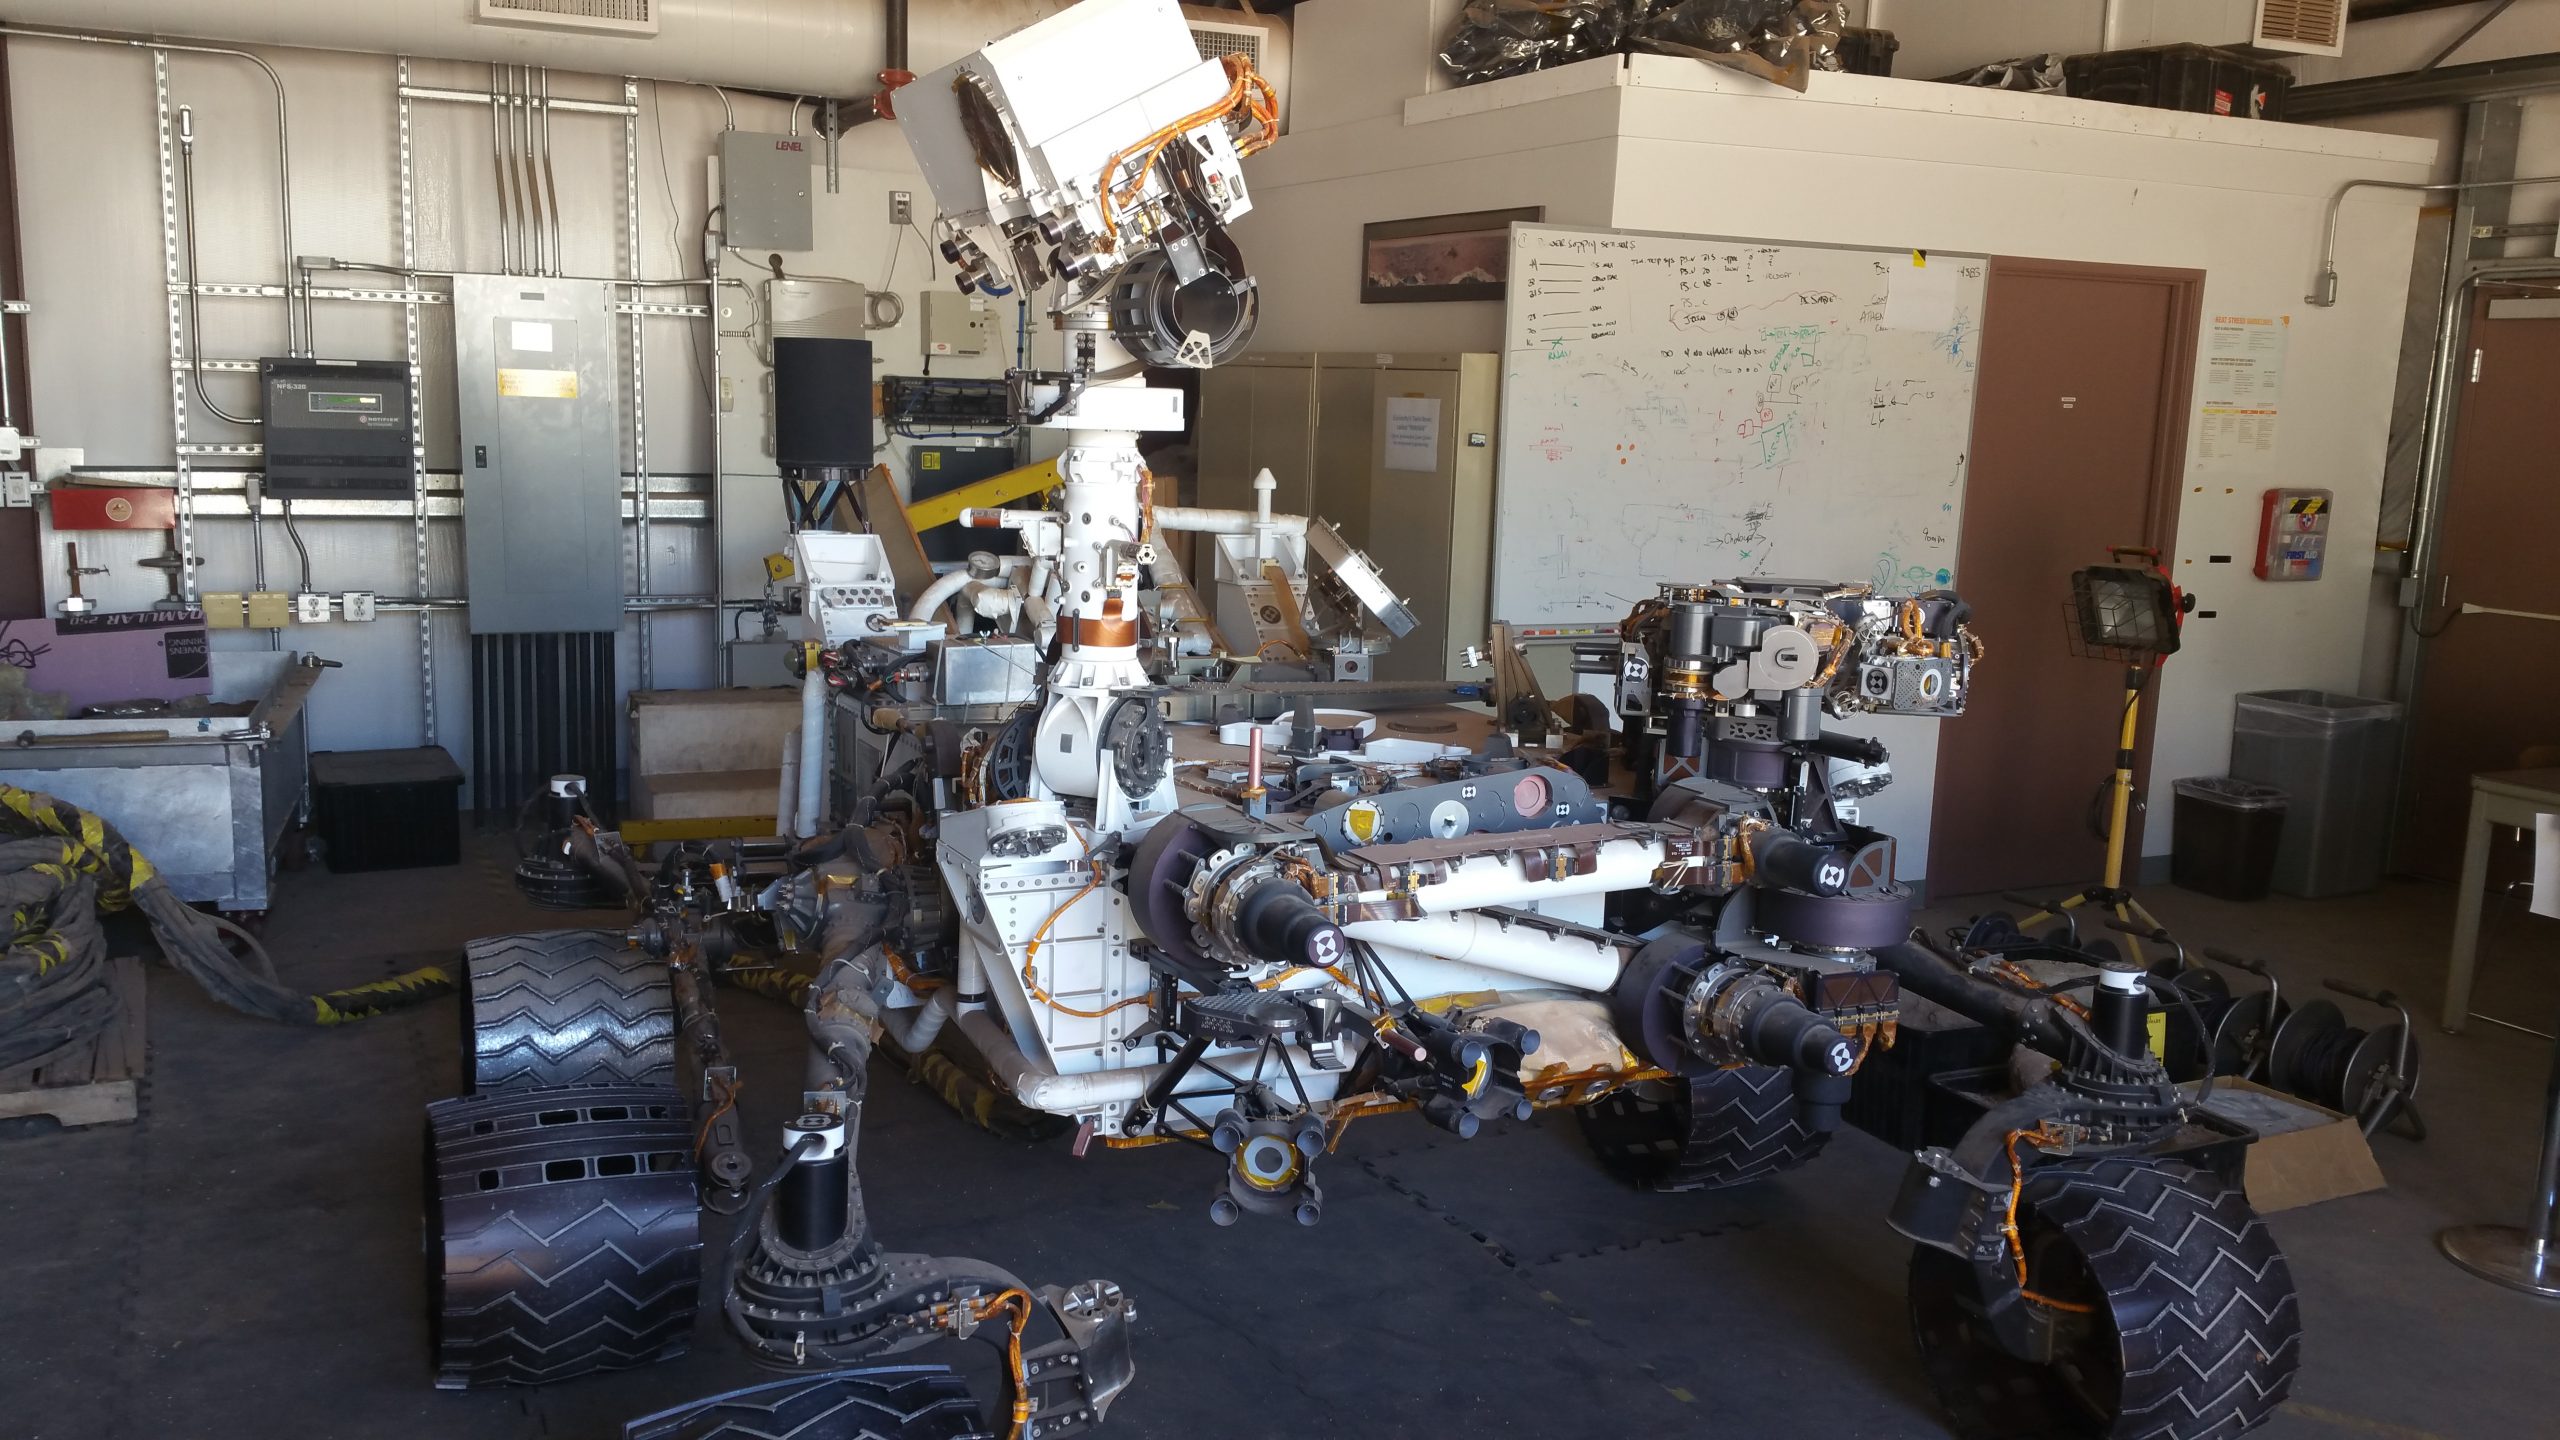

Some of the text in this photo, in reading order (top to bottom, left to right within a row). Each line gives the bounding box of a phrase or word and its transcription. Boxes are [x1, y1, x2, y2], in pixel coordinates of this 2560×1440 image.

[775, 140, 804, 152] LENEL
[2285, 551, 2318, 559] FIRST AID
[169, 646, 206, 655] OWENS
